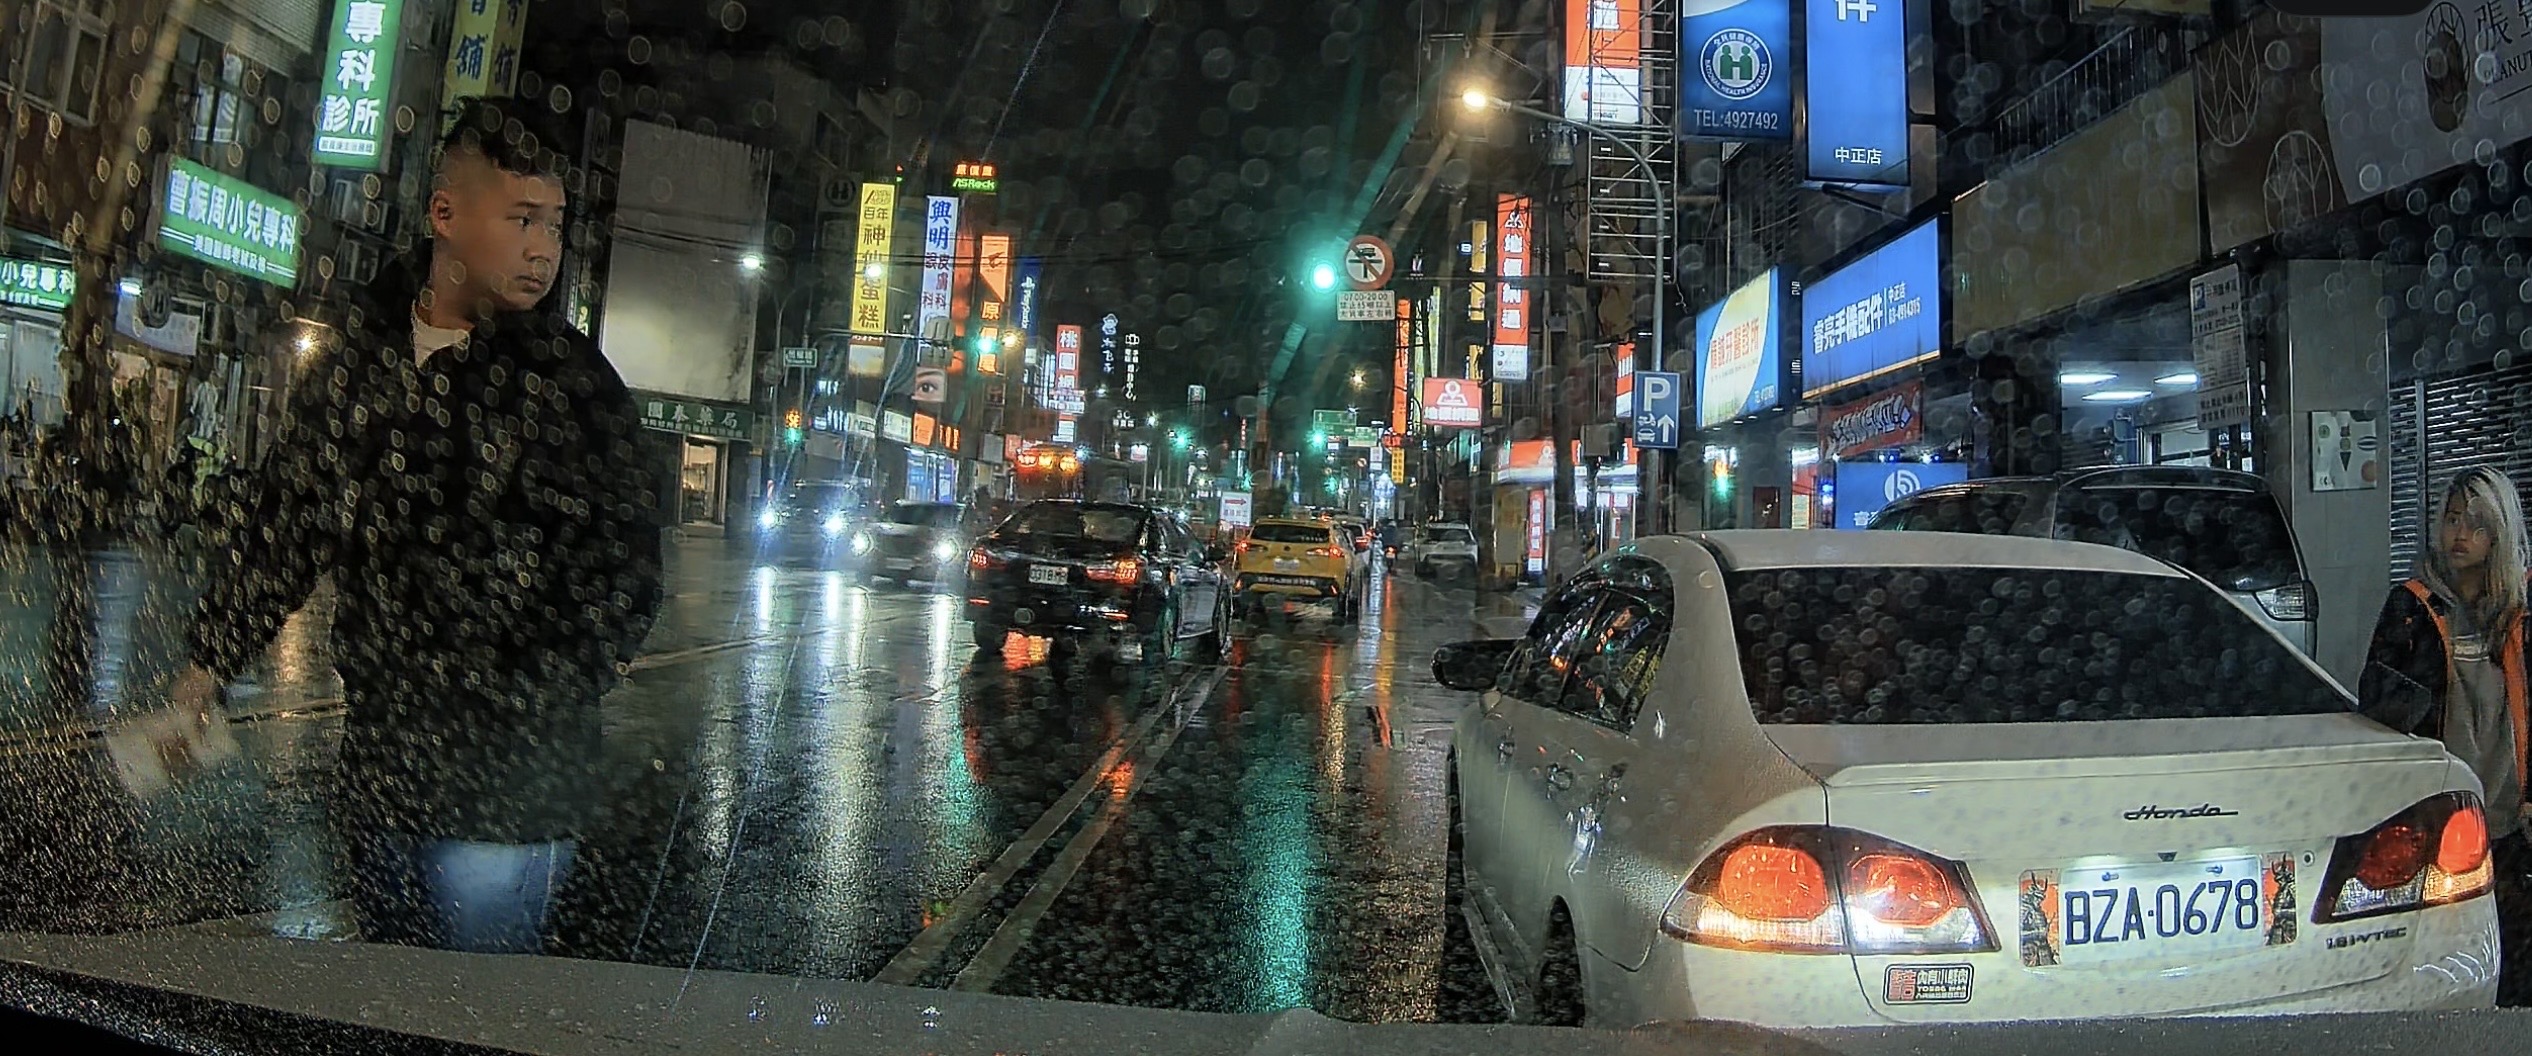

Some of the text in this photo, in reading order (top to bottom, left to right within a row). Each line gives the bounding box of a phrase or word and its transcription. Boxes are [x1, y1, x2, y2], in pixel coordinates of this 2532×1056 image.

[1694, 109, 1778, 130] TEL:4927492
[1834, 147, 1882, 165] 中正店
[929, 200, 952, 250] 興明
[1643, 377, 1671, 411] P
[2124, 803, 2238, 820] Honda
